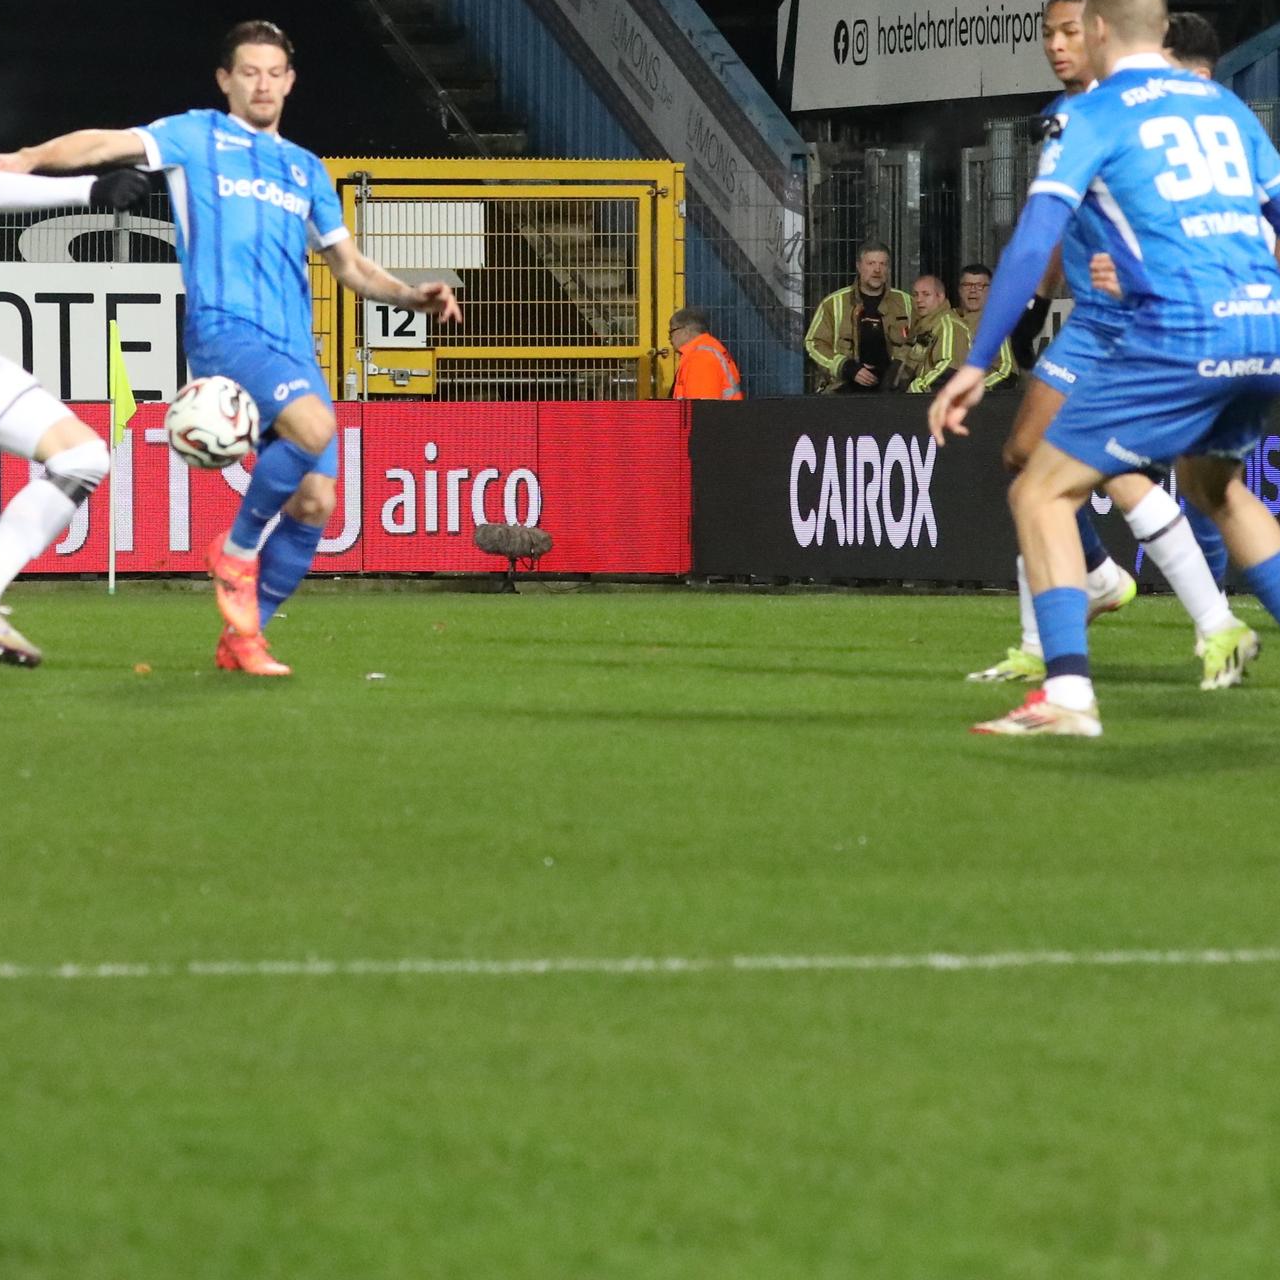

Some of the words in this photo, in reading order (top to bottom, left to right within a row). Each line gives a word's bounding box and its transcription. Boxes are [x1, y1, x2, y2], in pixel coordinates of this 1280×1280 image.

[1140, 115, 1254, 202] 38
[375, 304, 417, 338] 12
[382, 442, 542, 535] airco
[789, 433, 938, 549] CAIROX
